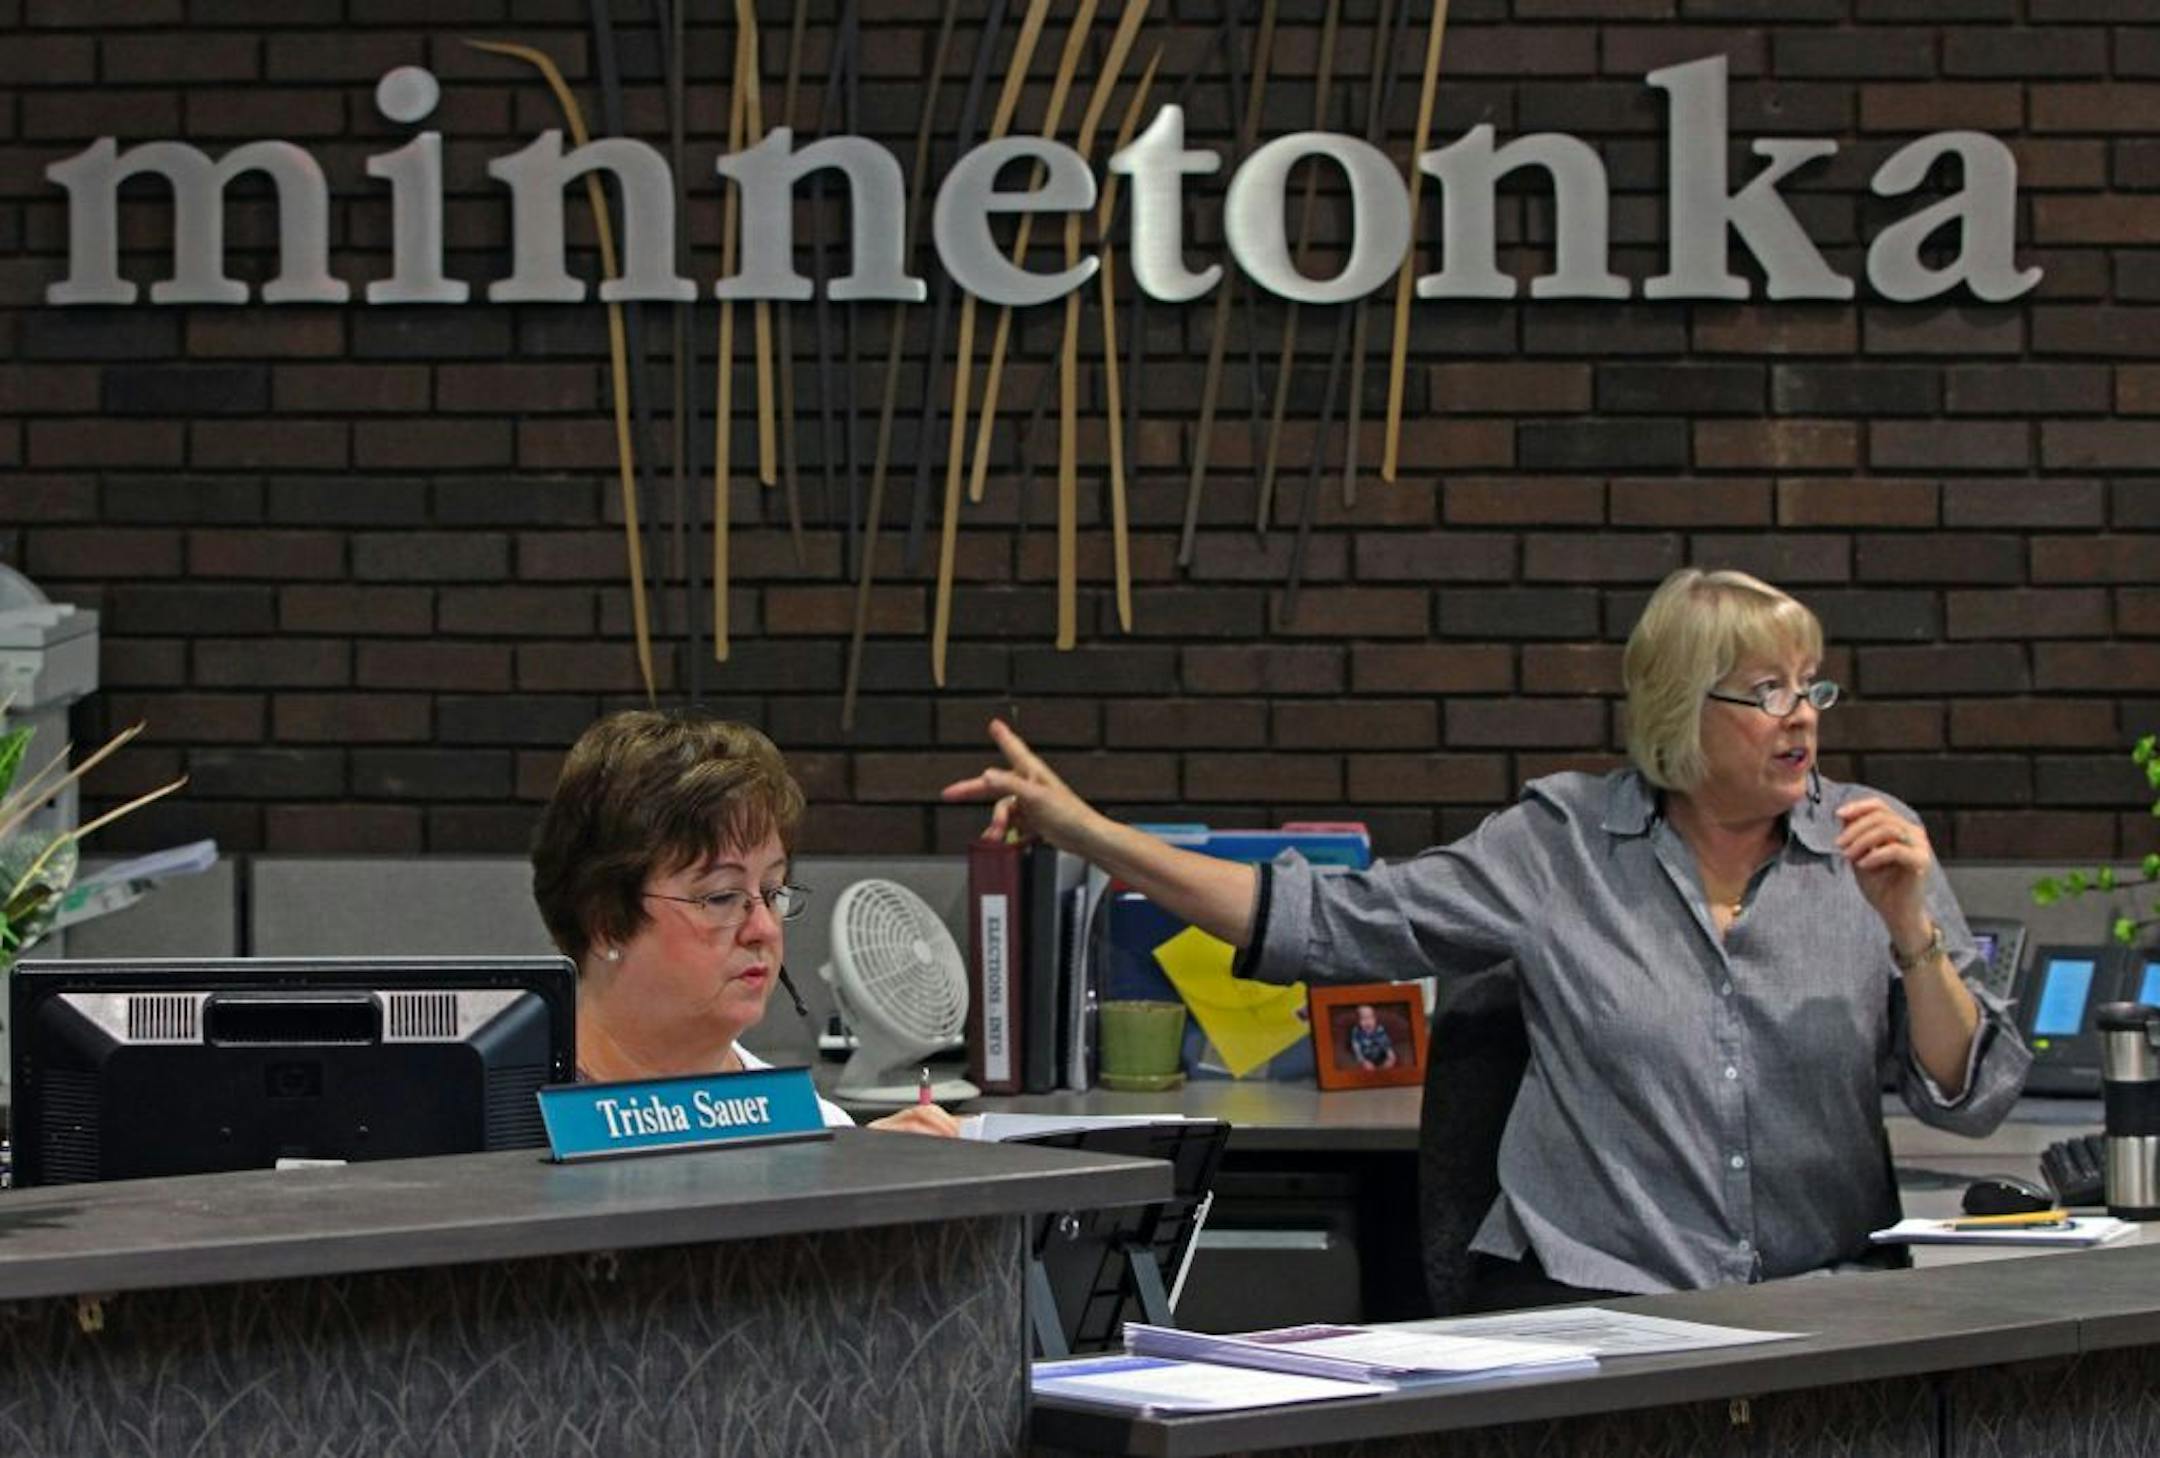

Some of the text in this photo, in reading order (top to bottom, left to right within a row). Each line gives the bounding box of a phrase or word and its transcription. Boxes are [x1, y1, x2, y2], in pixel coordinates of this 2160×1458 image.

[45, 54, 2043, 305] minnetonka
[989, 1017, 1002, 1055] INFO
[596, 1090, 770, 1138] Trisha Sauer
